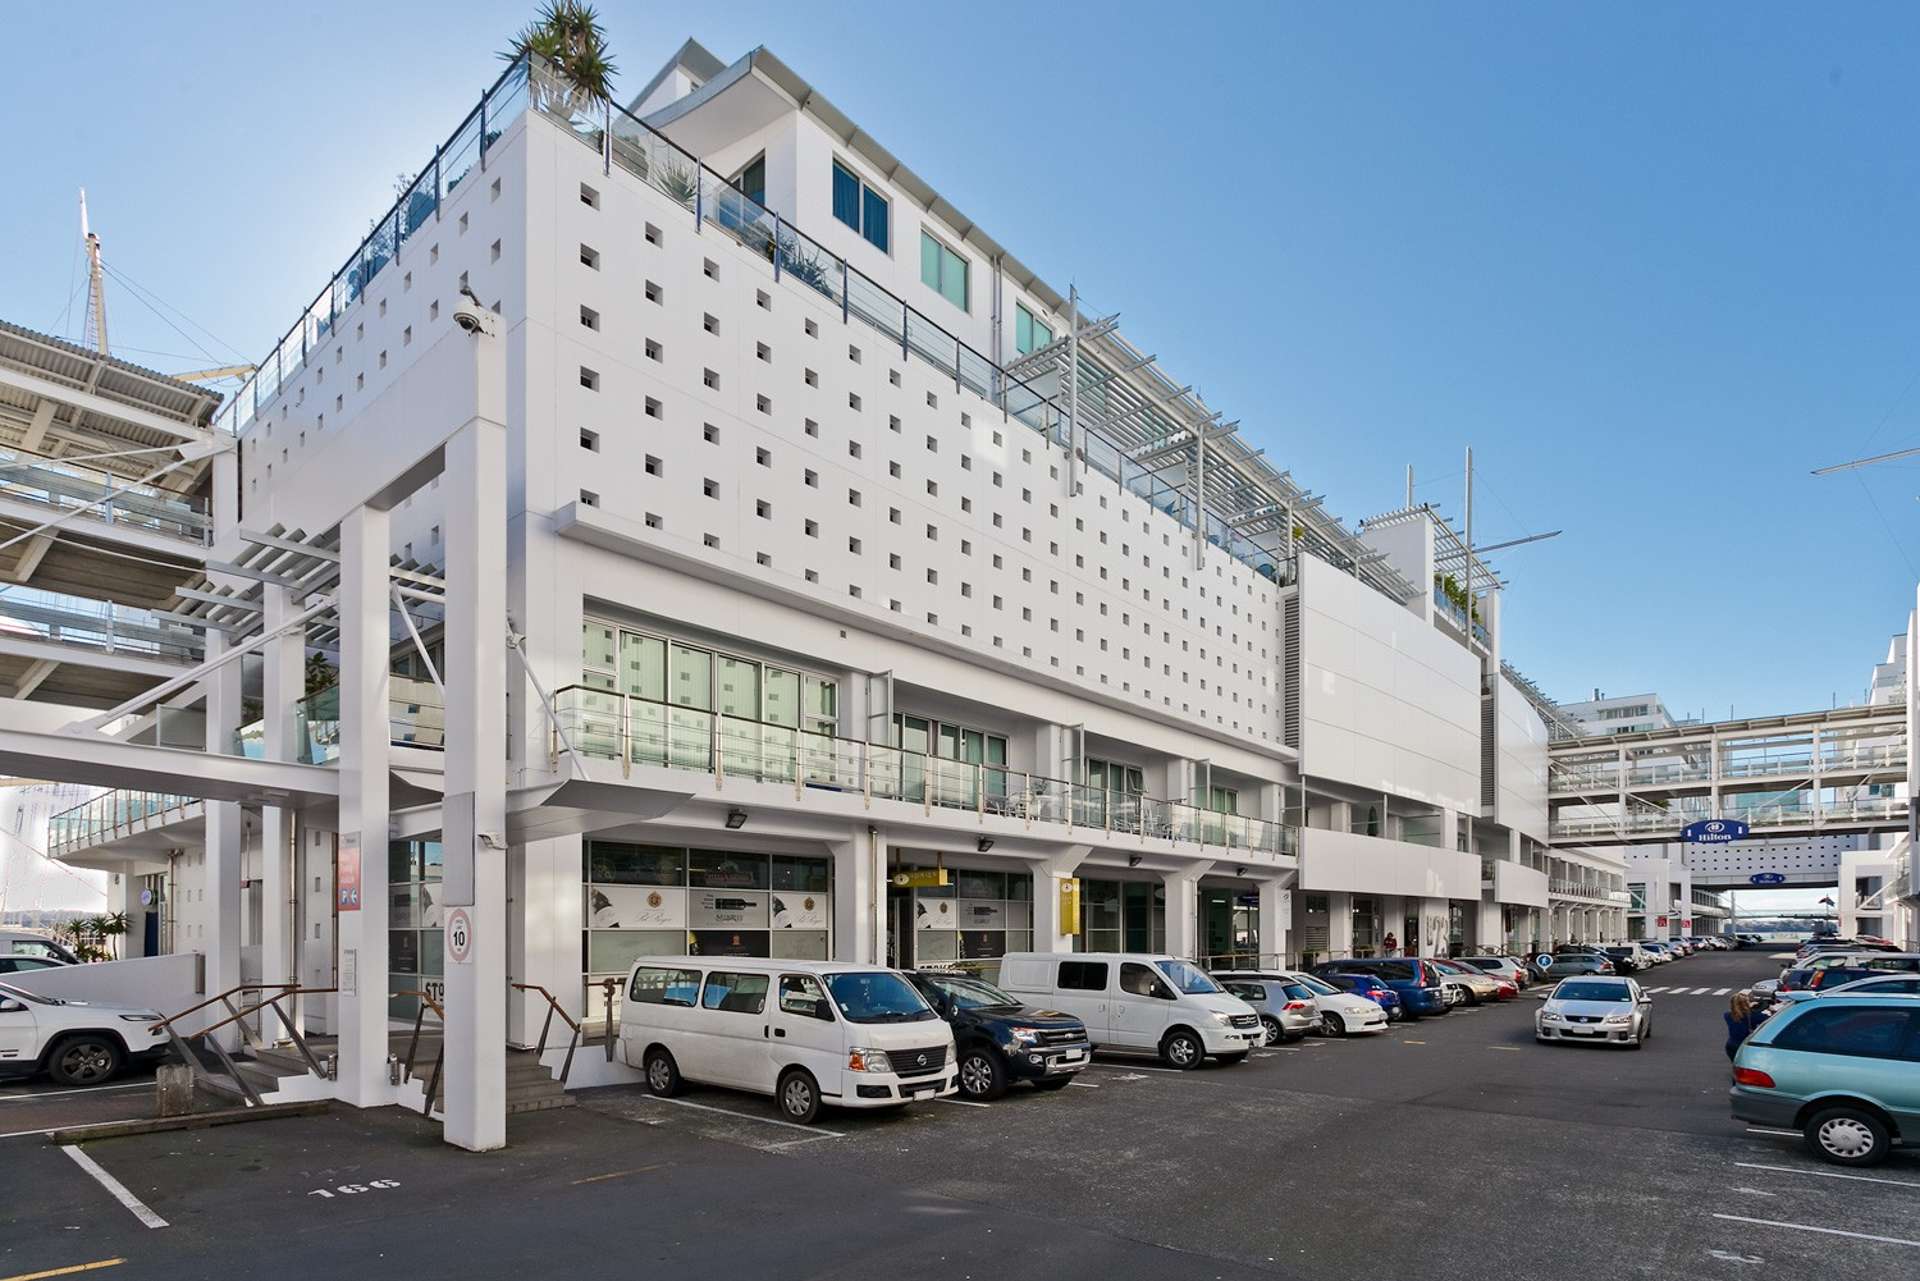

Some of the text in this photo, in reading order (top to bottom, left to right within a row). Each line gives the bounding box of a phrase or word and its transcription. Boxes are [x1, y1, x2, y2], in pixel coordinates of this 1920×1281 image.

[1698, 833, 1732, 841] Hilton
[453, 931, 465, 946] 10
[307, 1179, 401, 1198] 166
